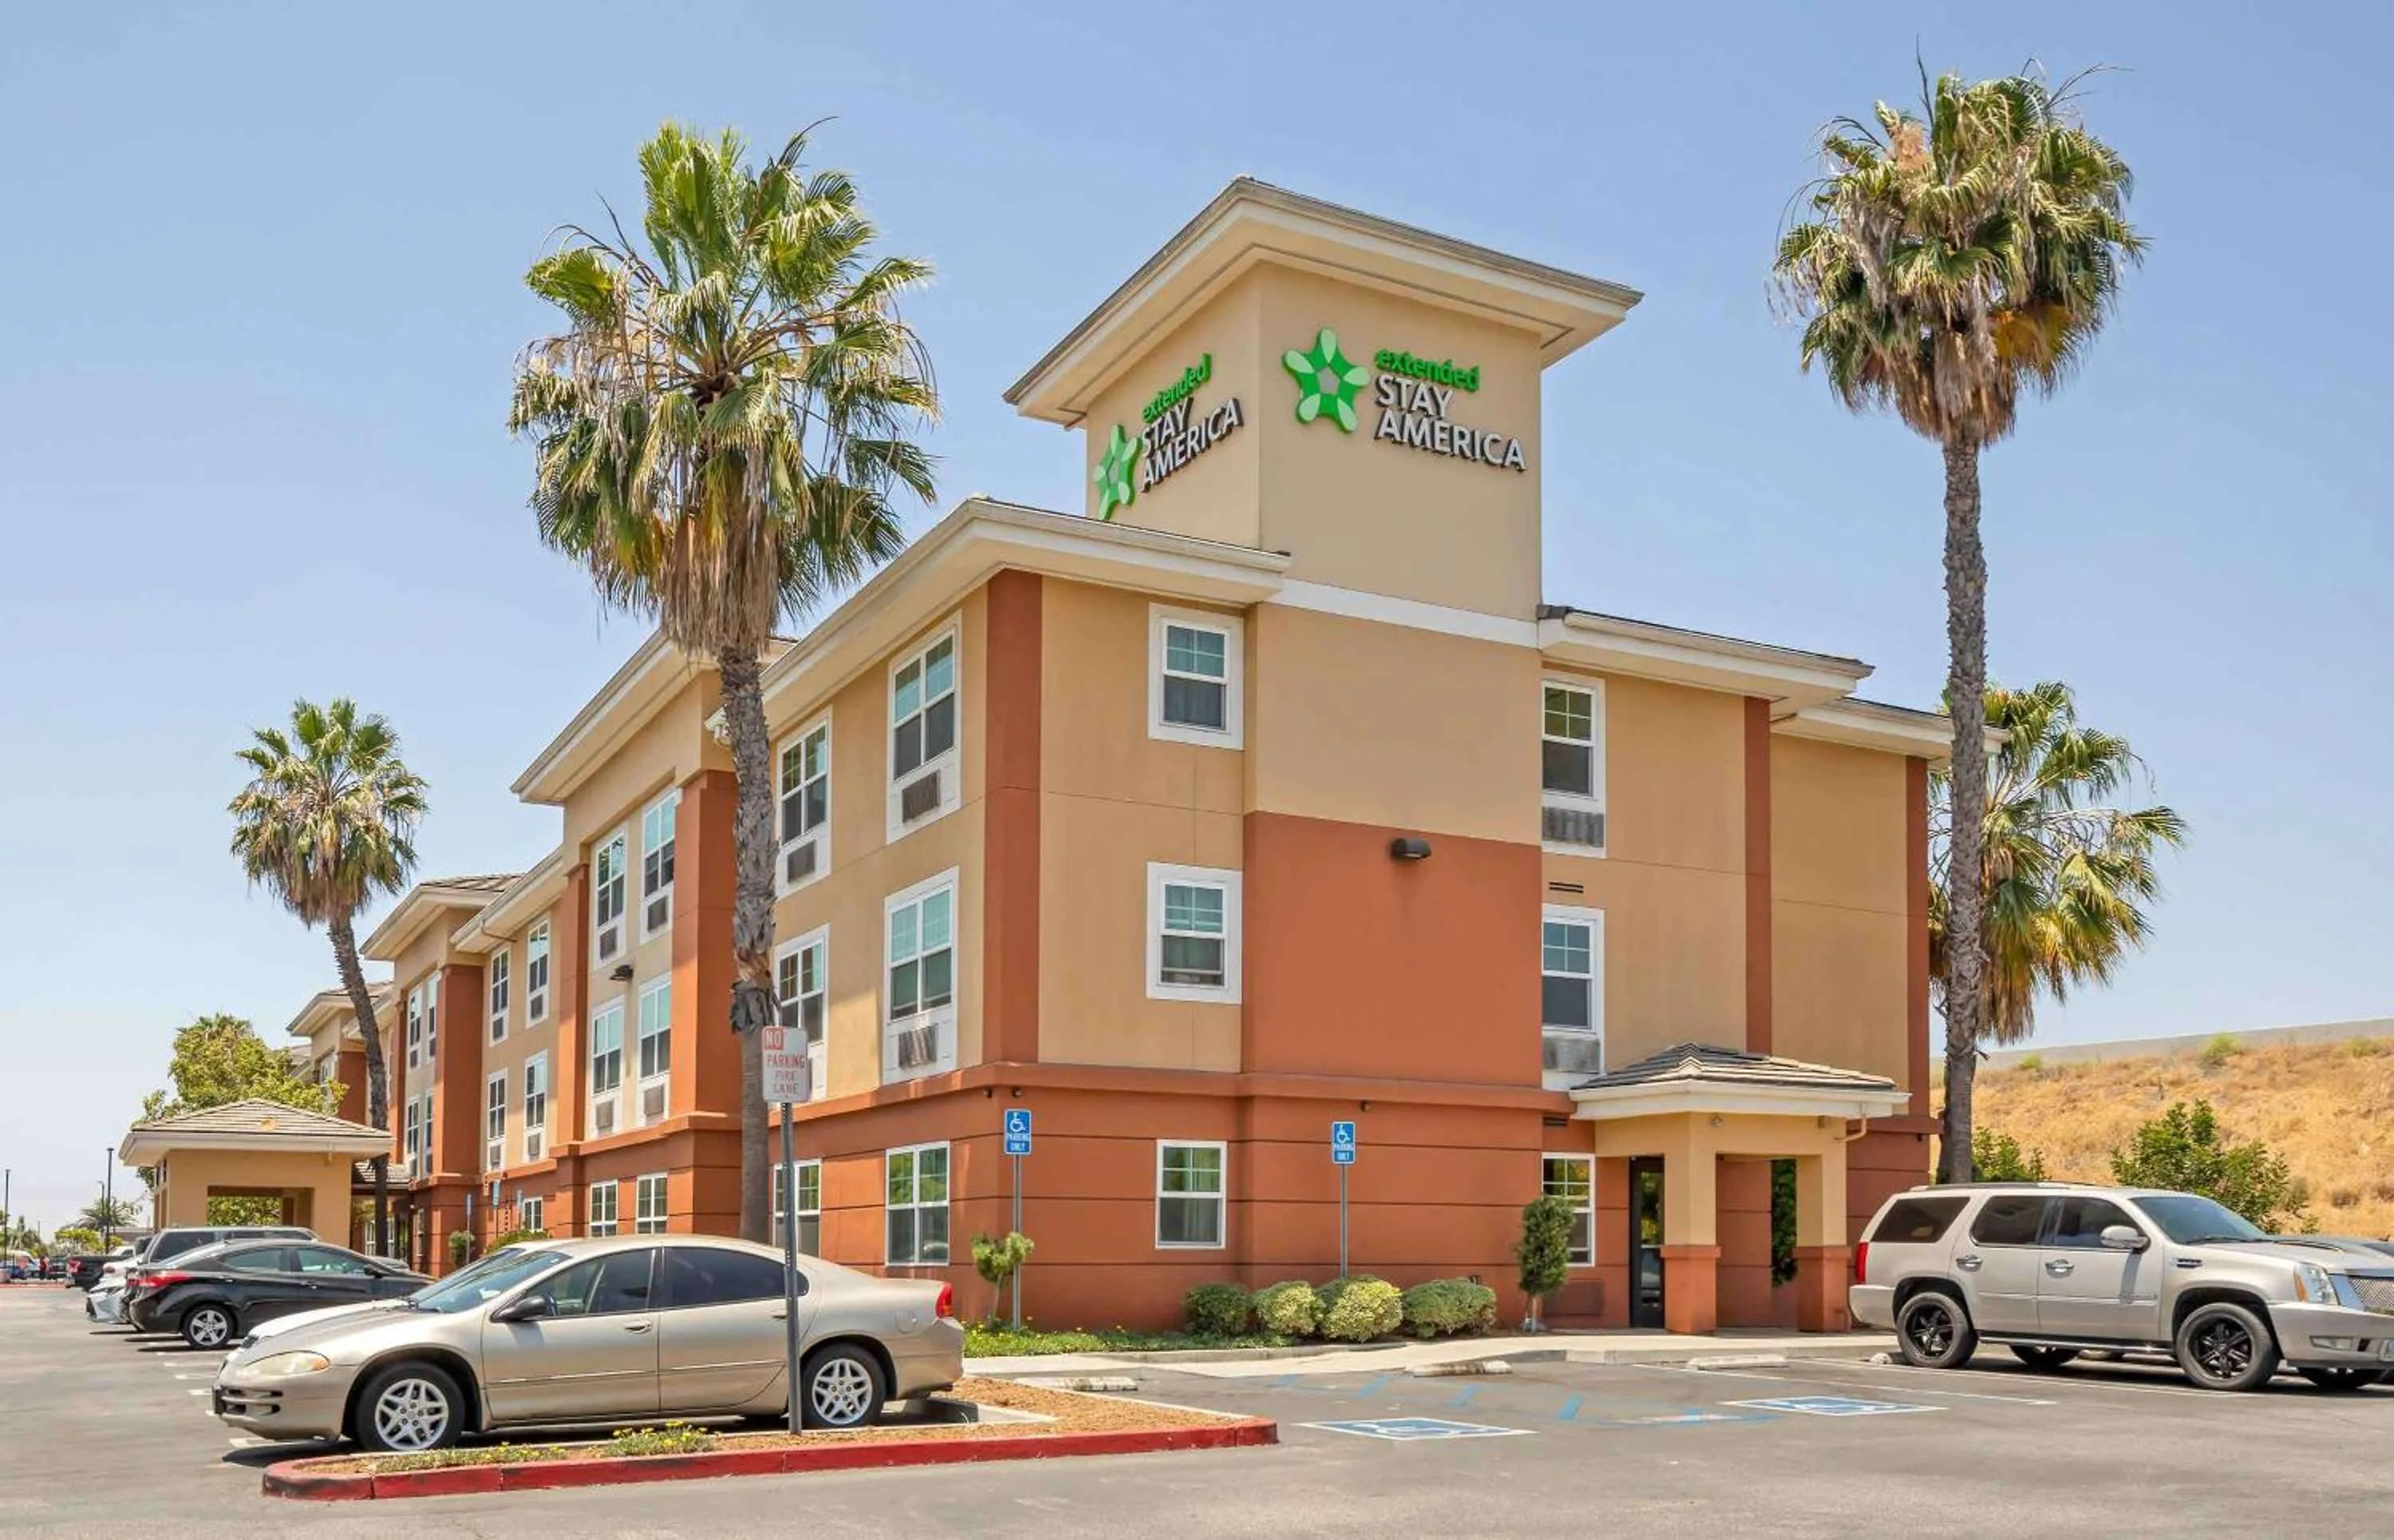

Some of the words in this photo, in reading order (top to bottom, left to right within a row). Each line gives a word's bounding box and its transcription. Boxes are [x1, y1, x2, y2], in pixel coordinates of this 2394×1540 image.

[1143, 353, 1212, 423] extended
[1374, 349, 1480, 392] extended
[1376, 373, 1454, 418] STAY
[1143, 397, 1194, 458] STAY
[1143, 397, 1244, 493] AMERICA
[1375, 408, 1527, 472] AMERICA
[766, 1029, 782, 1048] NO
[767, 1053, 805, 1068] PARKING
[773, 1084, 799, 1095] LANE
[775, 1070, 796, 1083] FIRE
